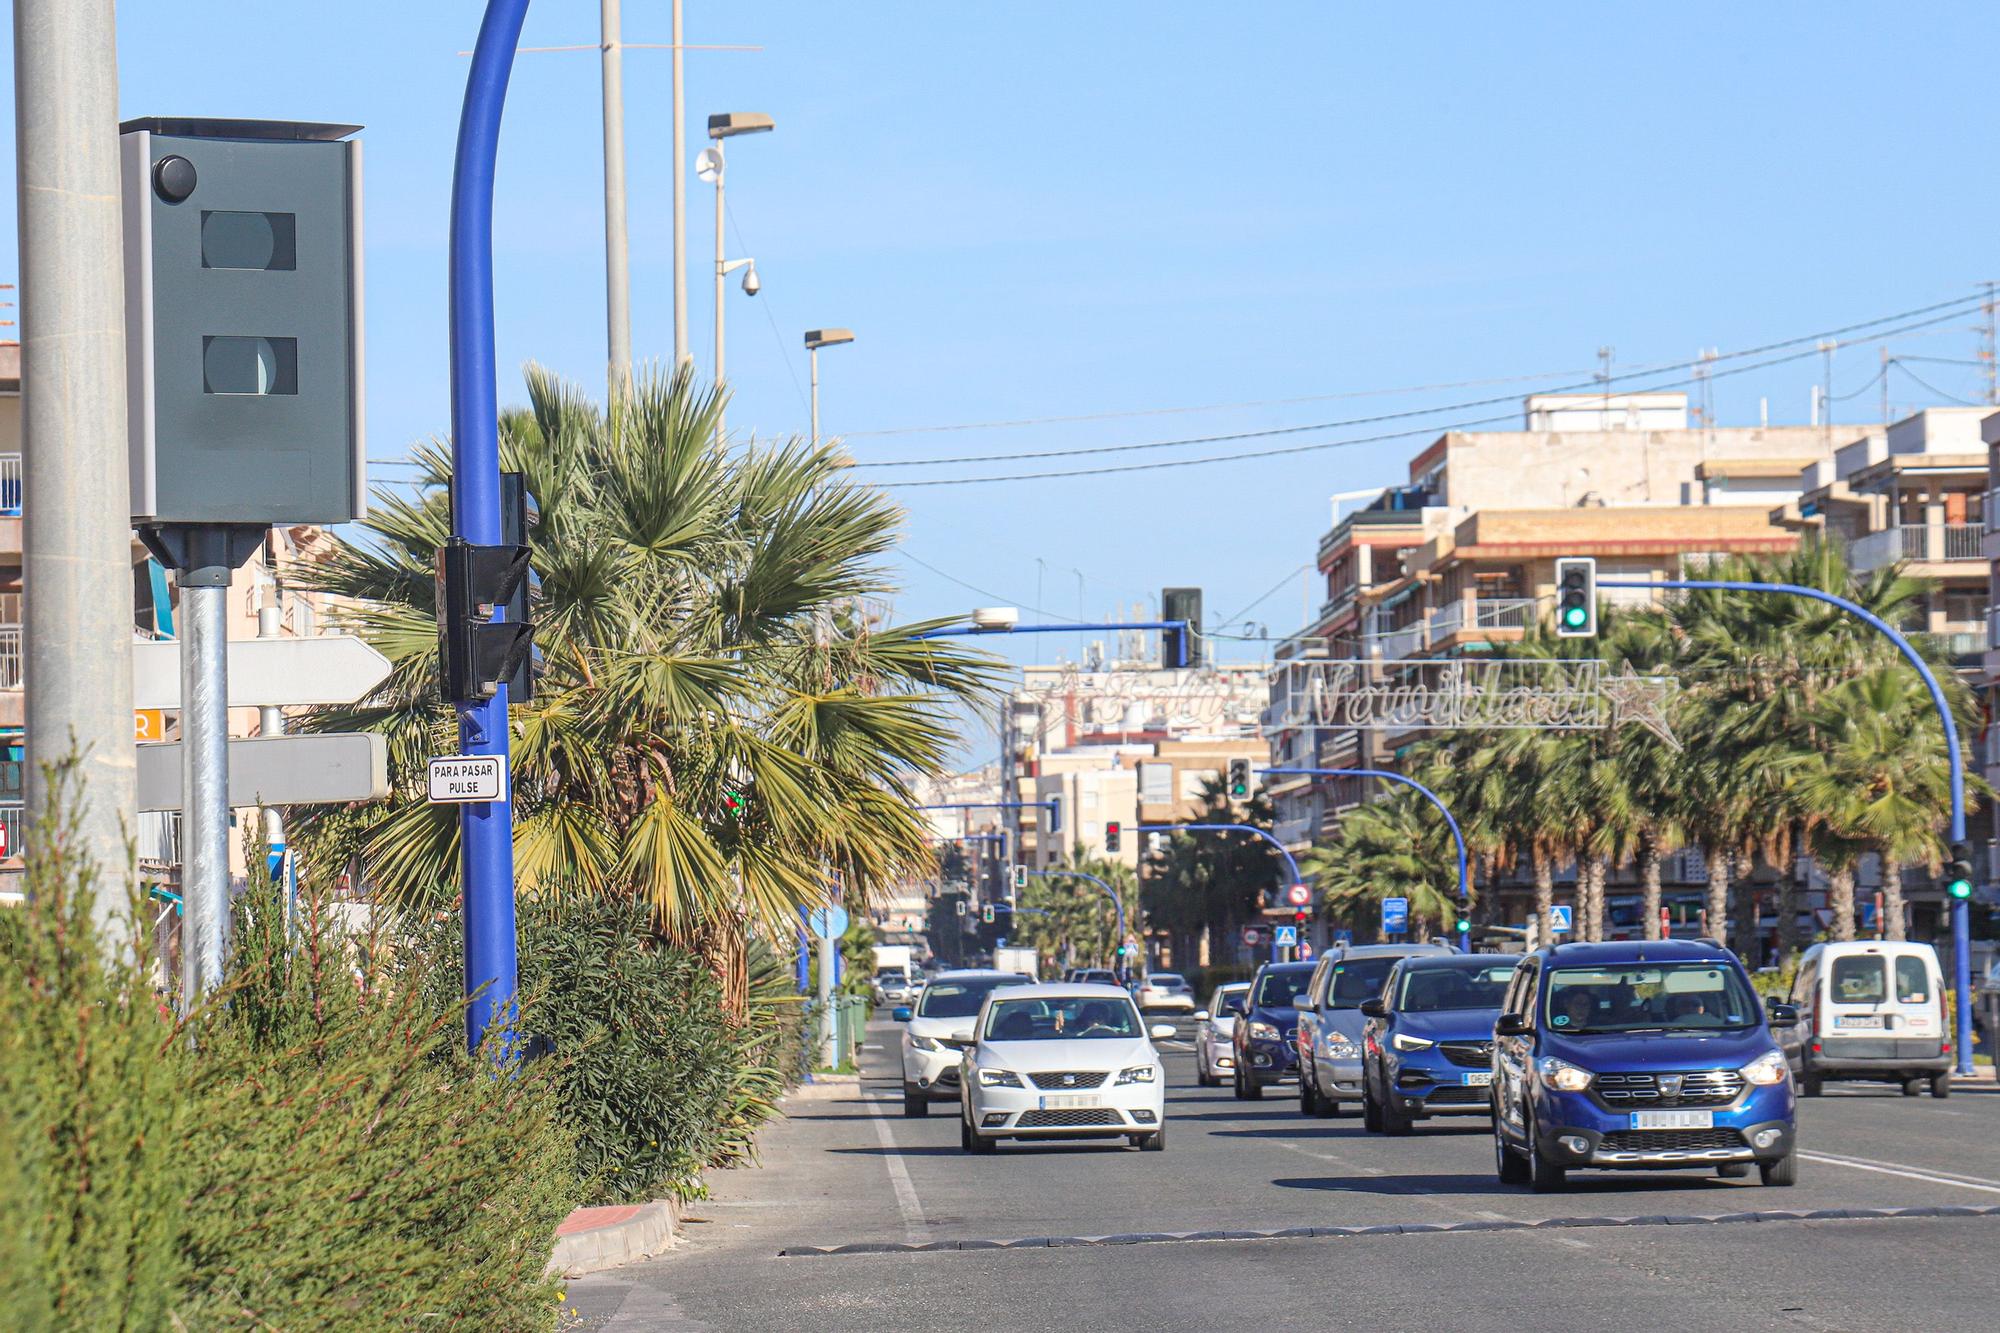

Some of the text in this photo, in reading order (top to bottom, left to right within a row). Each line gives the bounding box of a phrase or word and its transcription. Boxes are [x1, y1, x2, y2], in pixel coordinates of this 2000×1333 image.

[1281, 660, 1597, 727] Navidad
[135, 714, 149, 737] R
[434, 764, 493, 778] PARA PASAR
[449, 781, 478, 793] PULSE
[1471, 1074, 1490, 1084] 065
